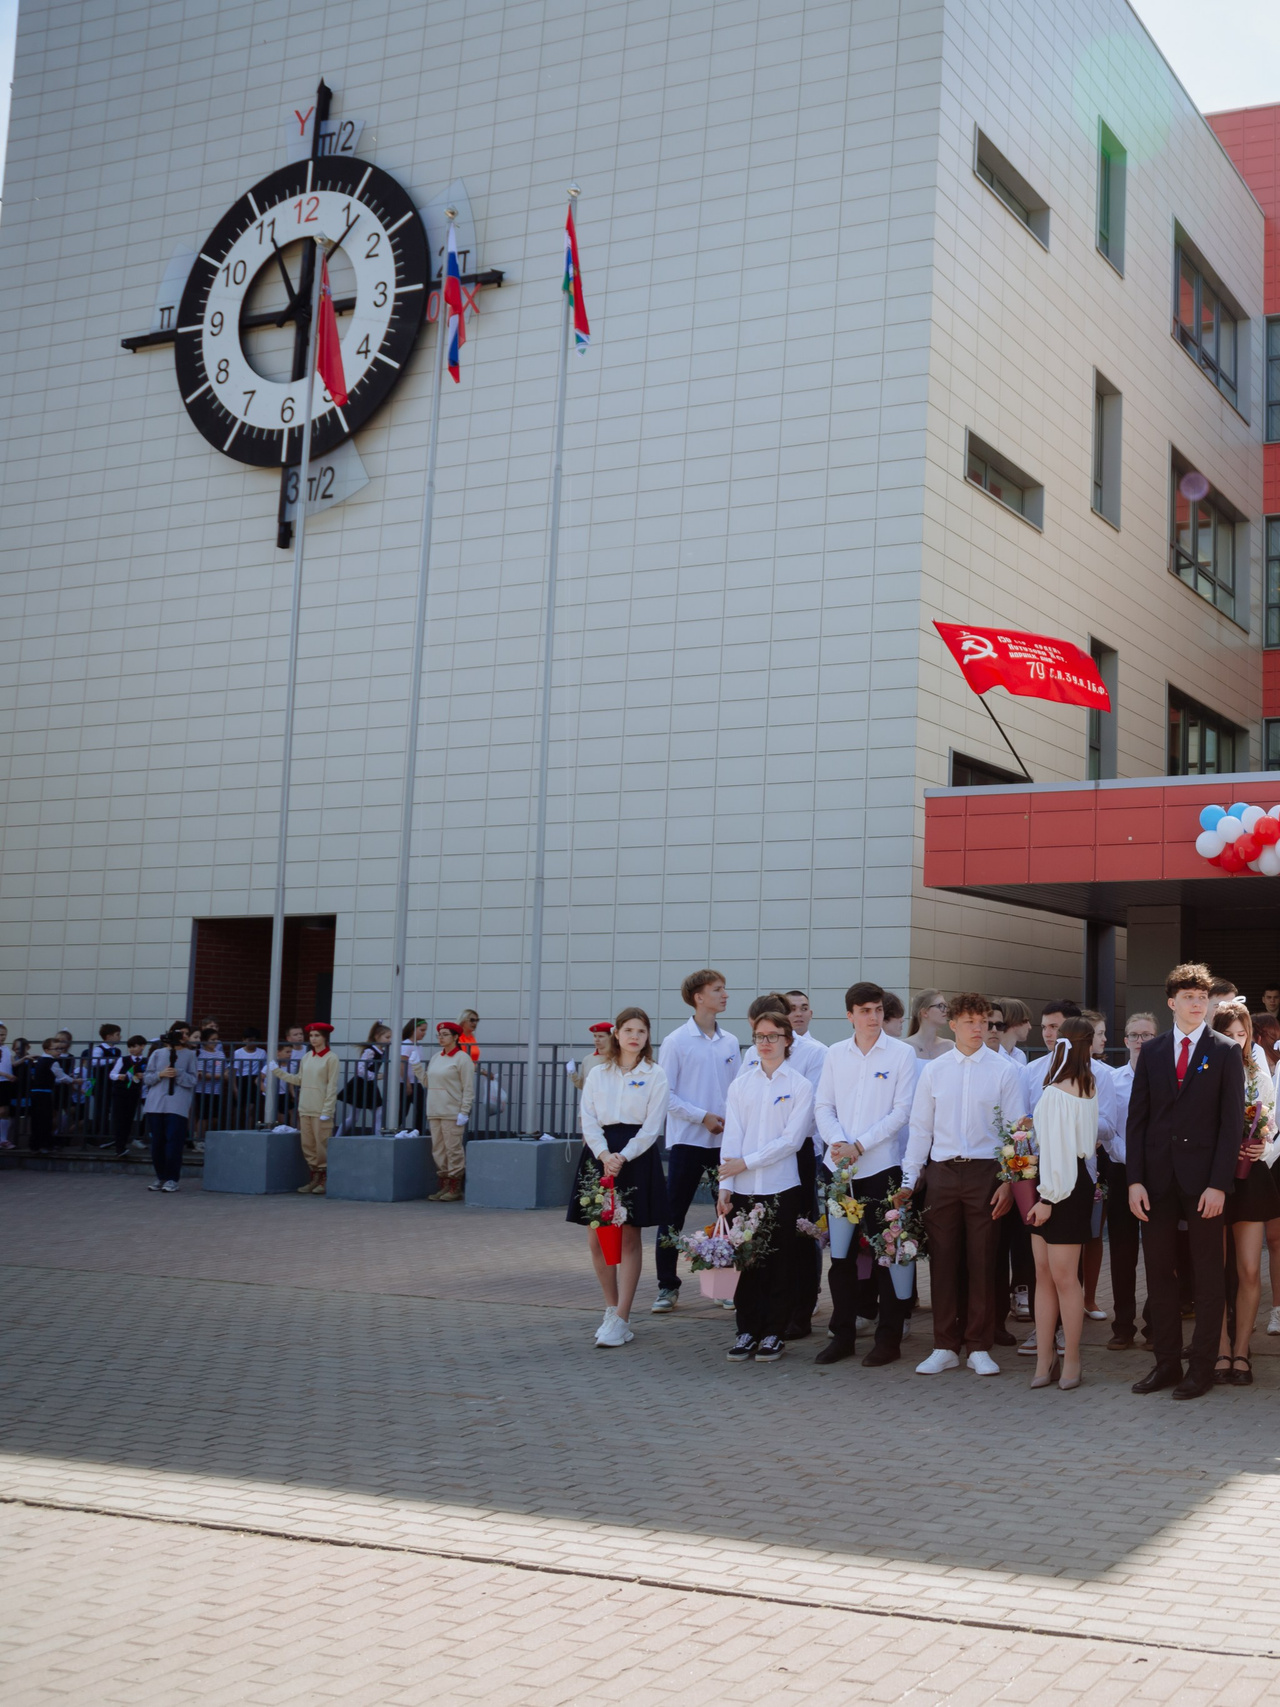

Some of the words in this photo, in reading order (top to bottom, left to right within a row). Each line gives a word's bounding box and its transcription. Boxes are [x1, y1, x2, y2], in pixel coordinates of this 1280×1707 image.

[293, 196, 320, 224] 12
[341, 201, 352, 228] 1
[255, 217, 276, 245] 11
[364, 232, 381, 259] 2
[222, 259, 247, 288] 10
[373, 281, 388, 308] 3
[210, 311, 224, 337] 9
[356, 333, 371, 360] 4
[215, 358, 230, 385] 8
[242, 389, 257, 417] 7
[281, 396, 295, 424] 6
[1026, 662, 1045, 679] 79
